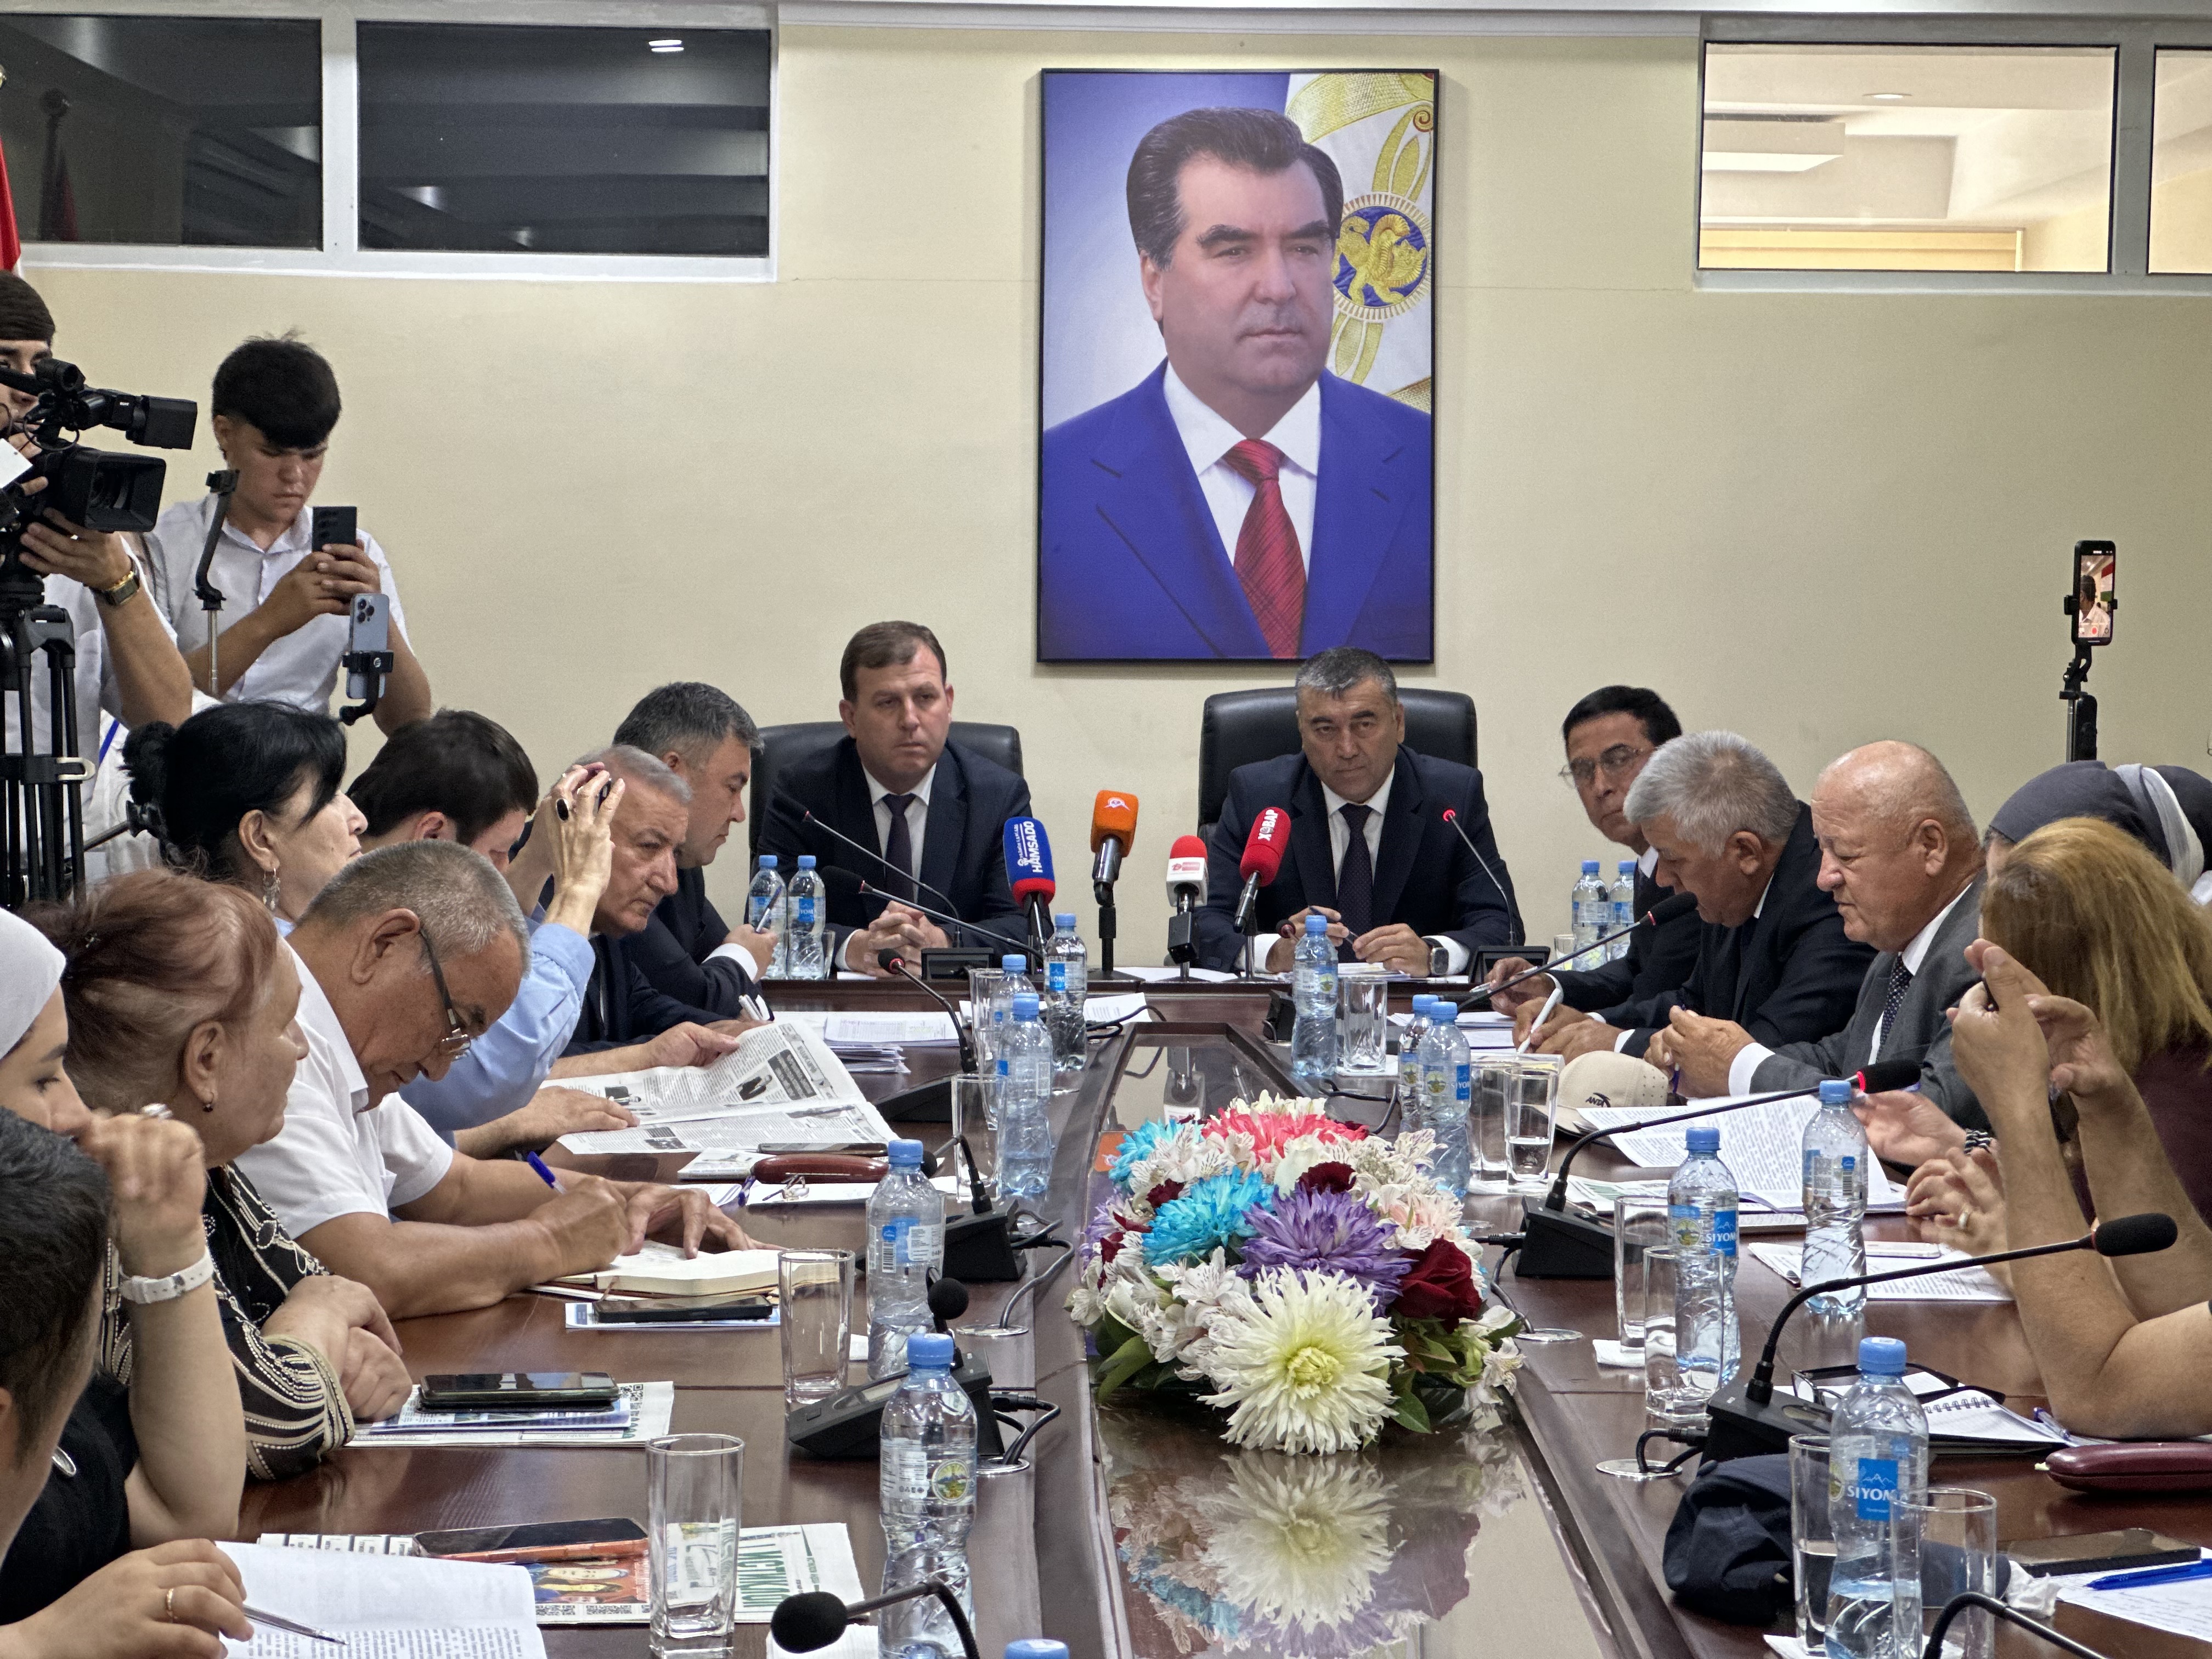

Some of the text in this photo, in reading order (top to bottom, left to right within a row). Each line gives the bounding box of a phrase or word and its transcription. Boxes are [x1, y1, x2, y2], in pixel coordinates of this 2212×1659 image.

[1257, 809, 1278, 842] ХОВАР
[1023, 821, 1043, 872] HAMSADO
[1706, 1232, 1736, 1243] SIYOM
